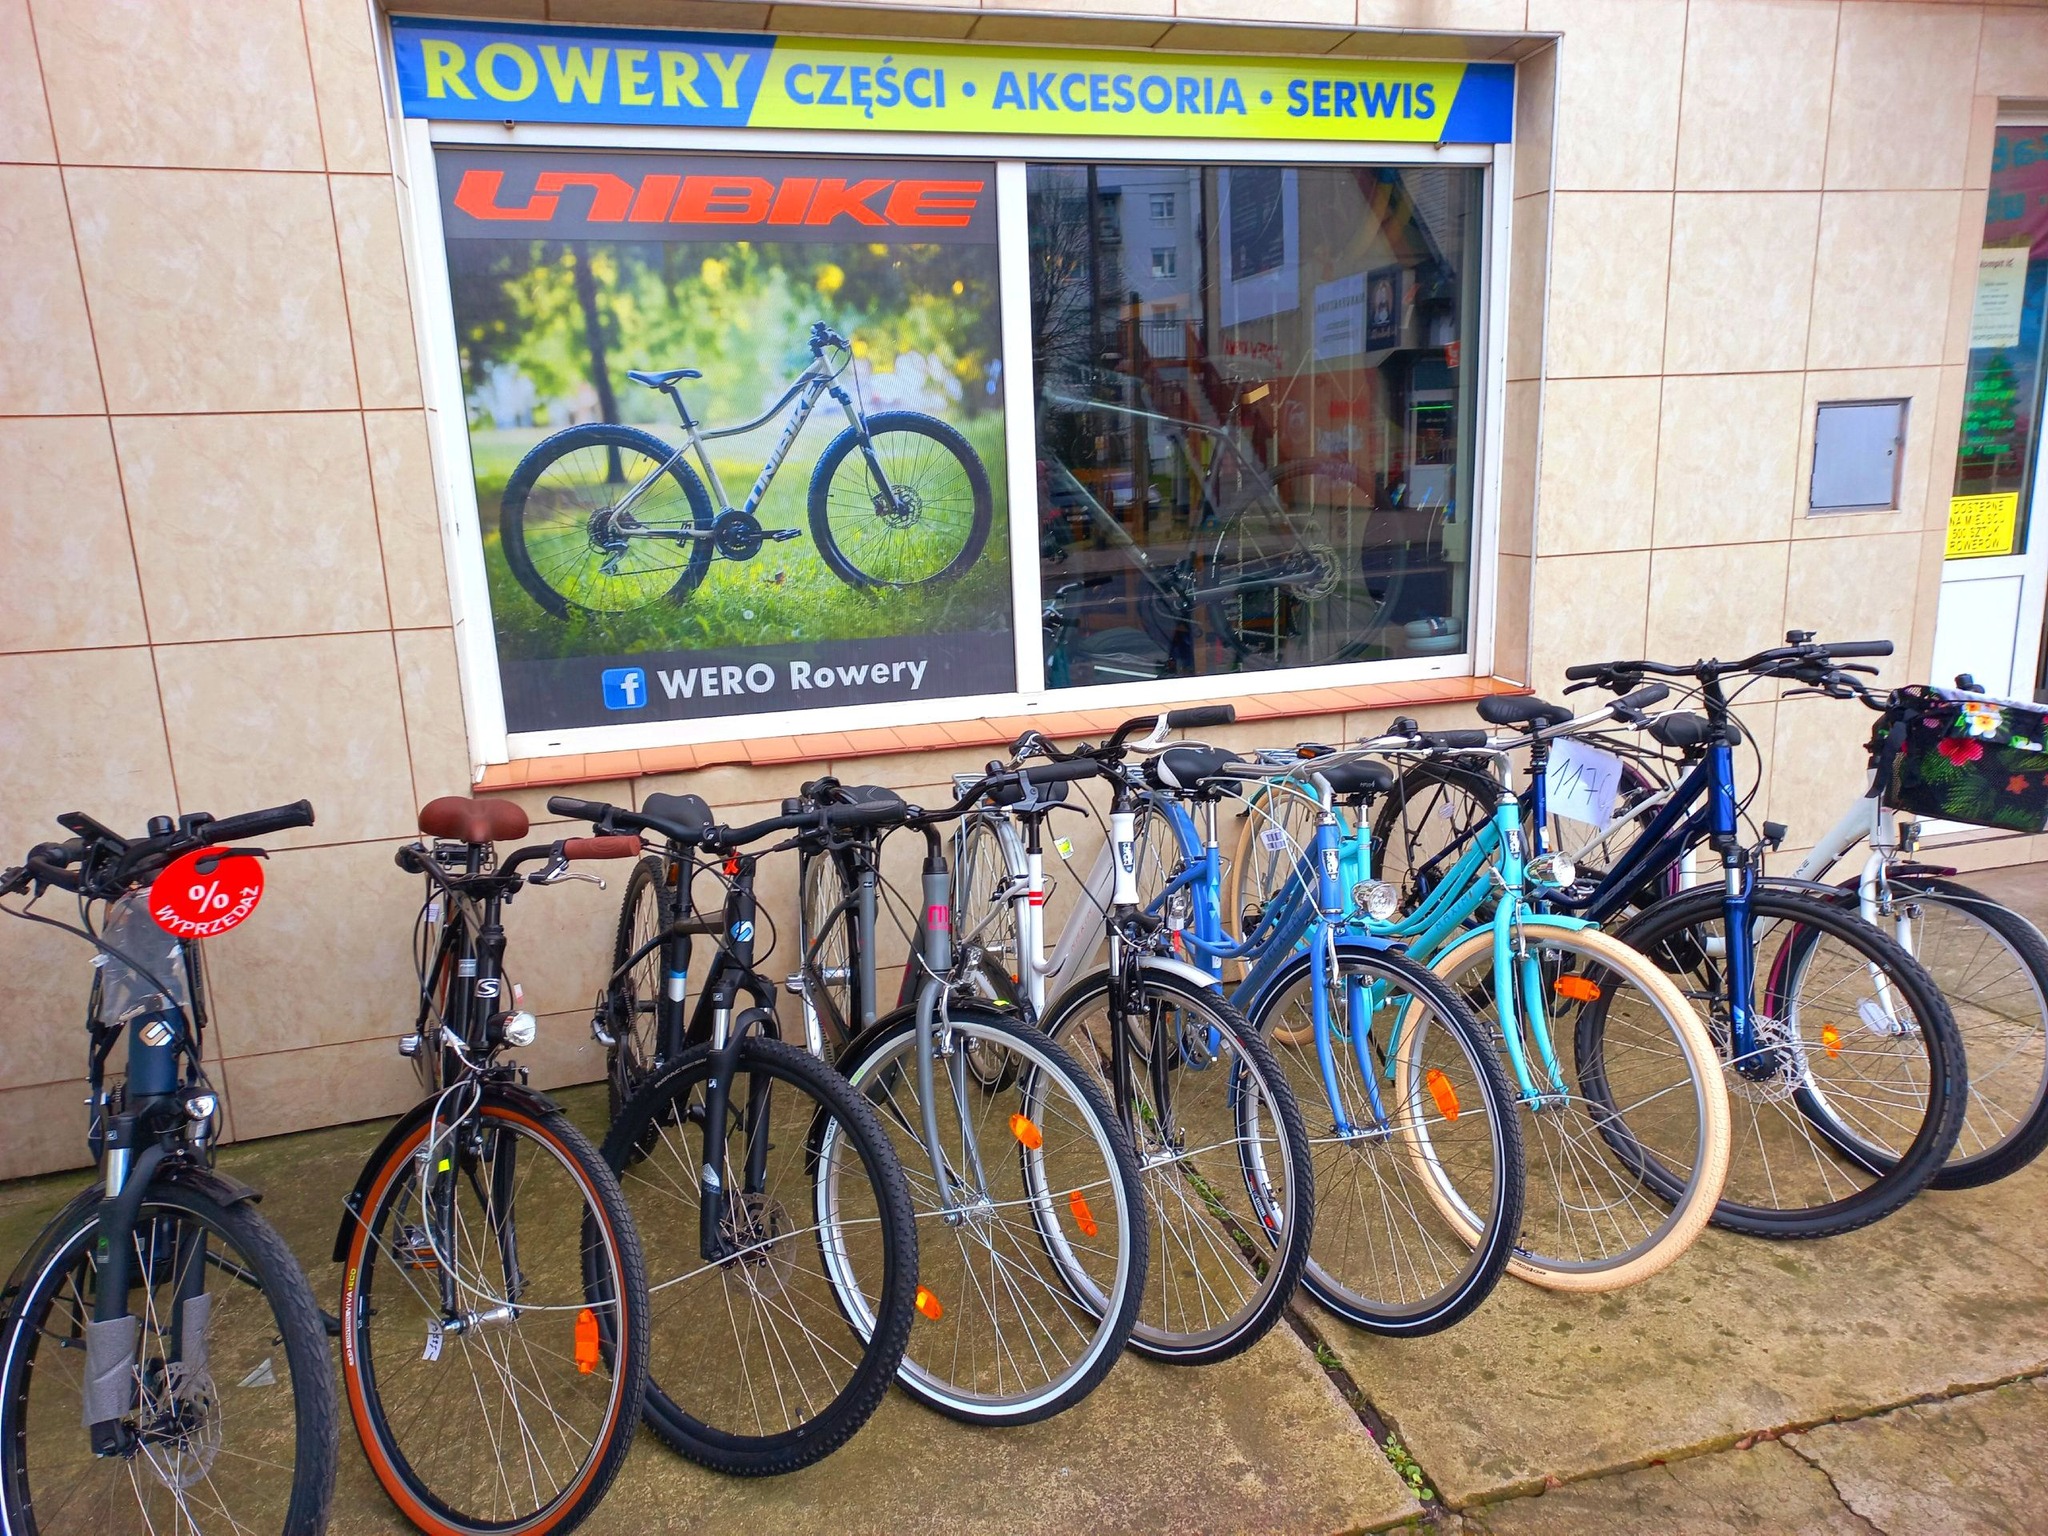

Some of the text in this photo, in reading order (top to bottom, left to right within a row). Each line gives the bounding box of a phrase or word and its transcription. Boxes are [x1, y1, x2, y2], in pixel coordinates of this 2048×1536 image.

[420, 38, 750, 108] ROWERY
[783, 55, 1436, 119] CZĘŚCI AKCESORIA SERWIS
[453, 169, 985, 226] UNIBIKE
[657, 663, 776, 699] WERO
[790, 659, 928, 690] Rowery
